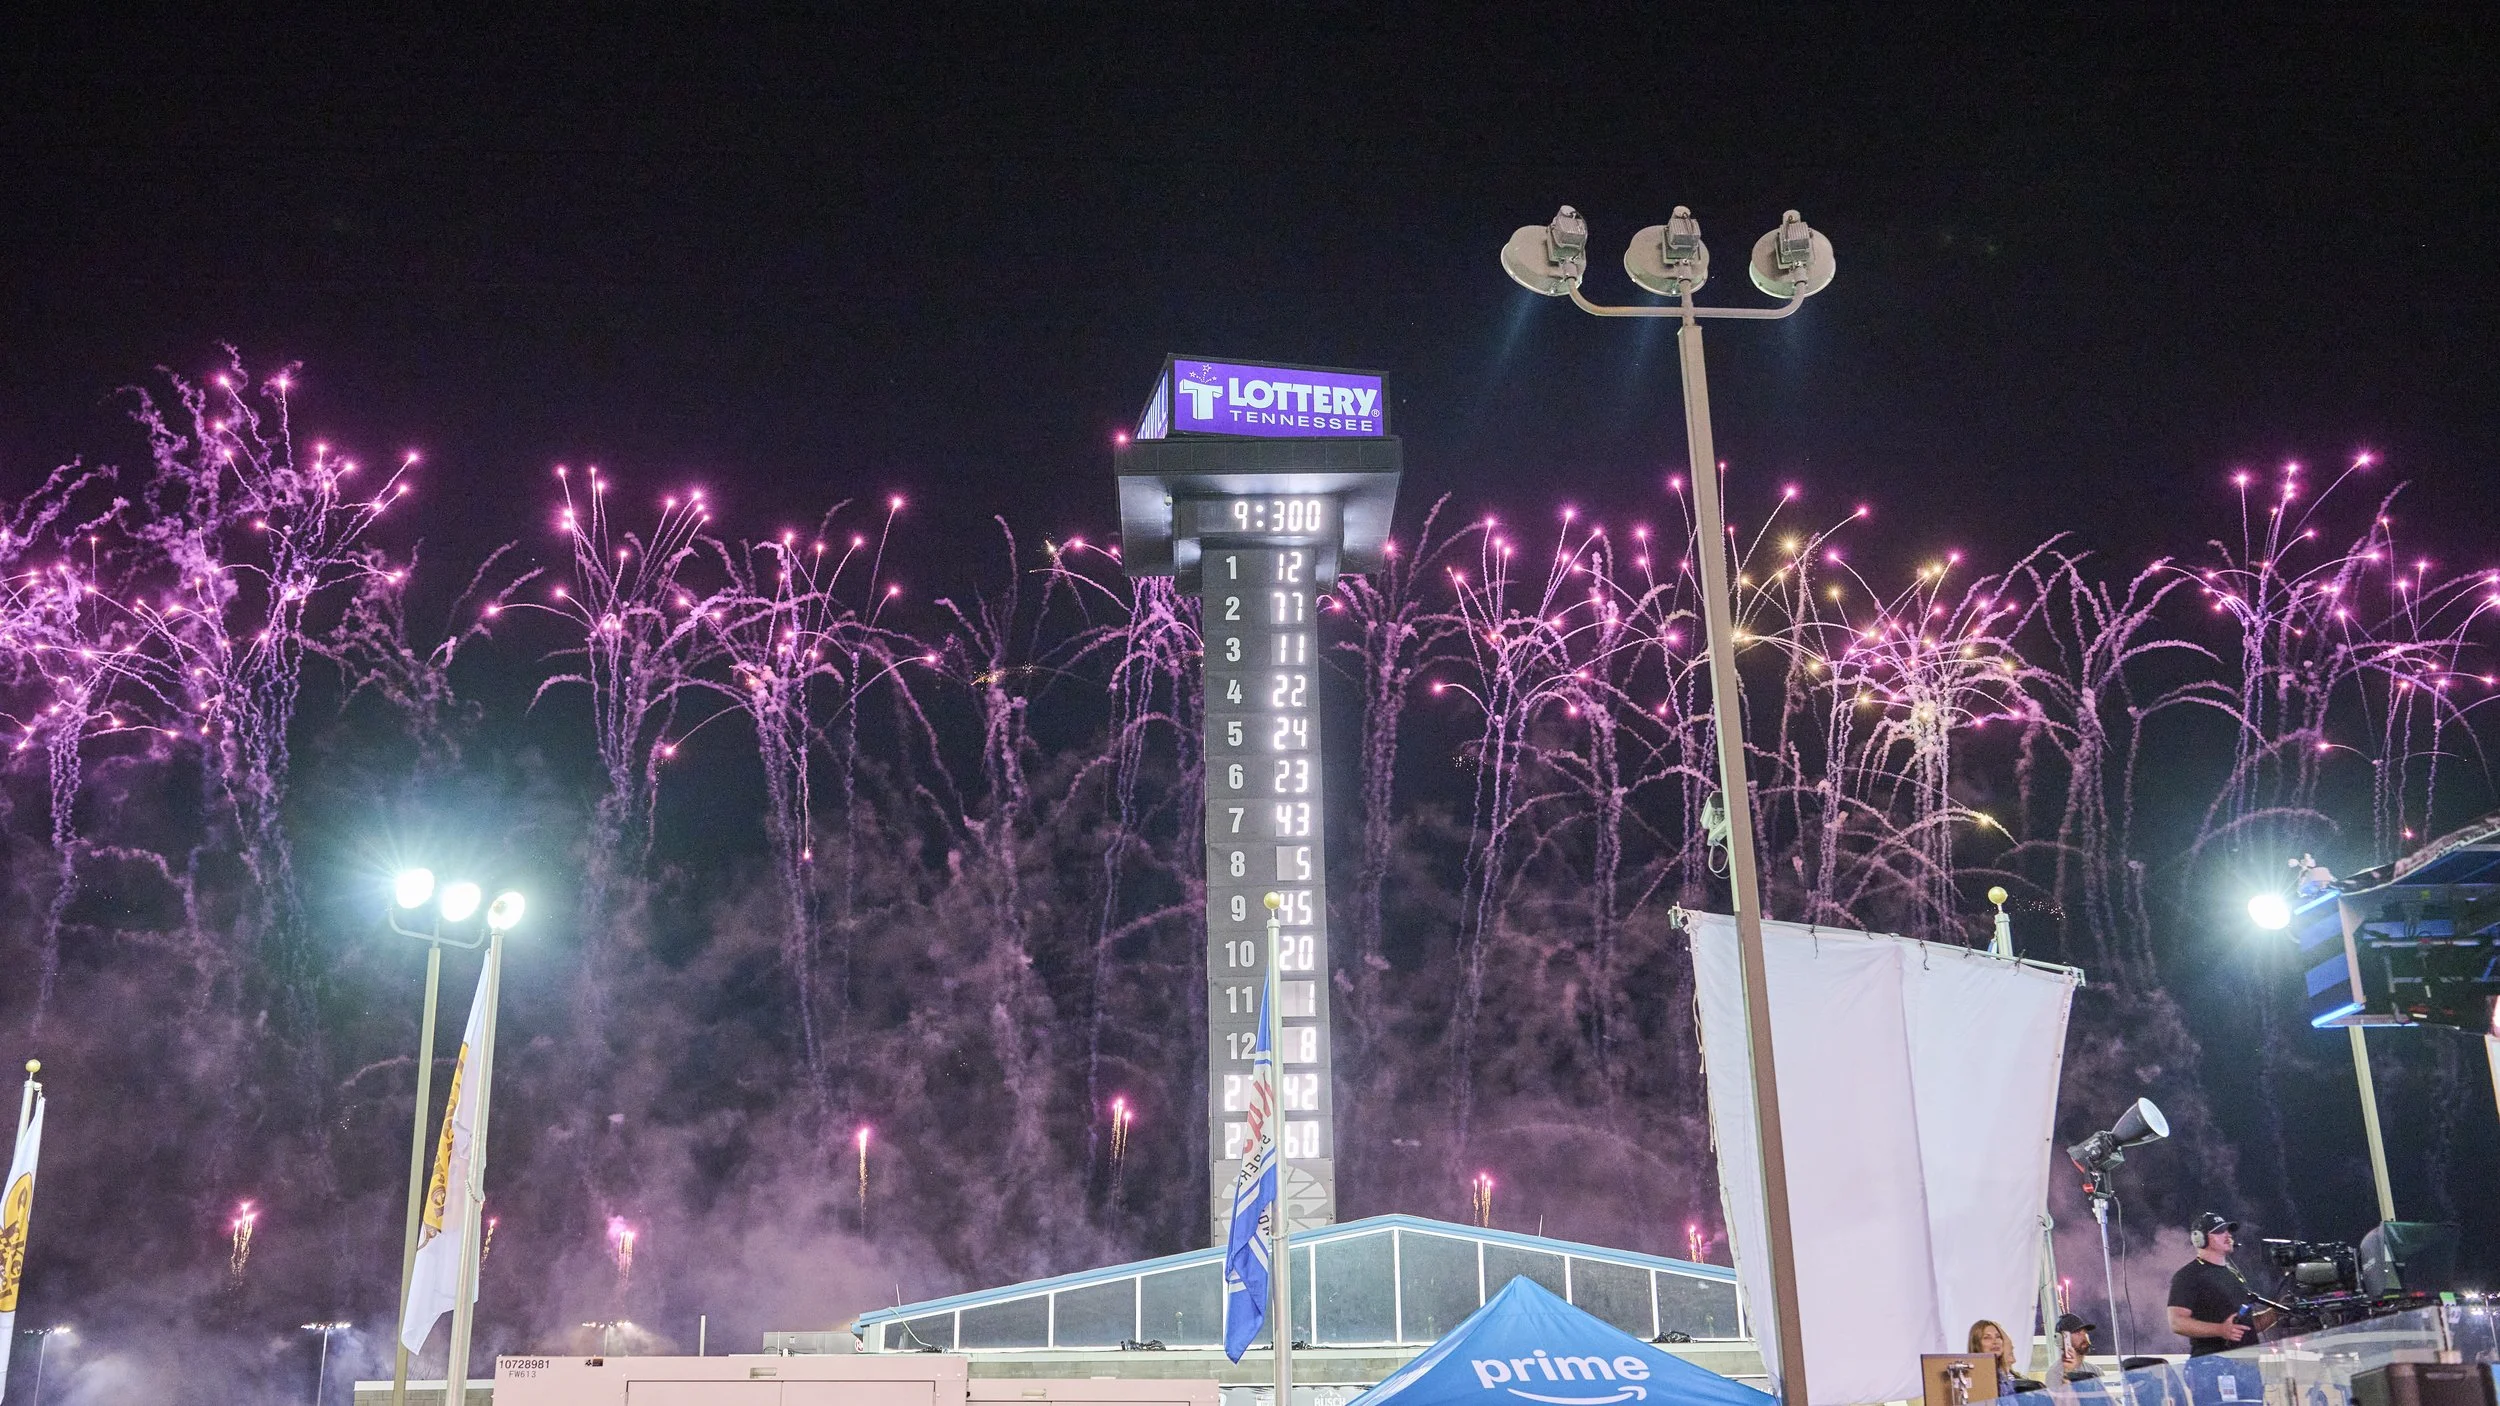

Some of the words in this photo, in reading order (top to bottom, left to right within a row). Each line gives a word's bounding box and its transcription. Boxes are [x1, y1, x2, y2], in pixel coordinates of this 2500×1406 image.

[1229, 377, 1378, 417] LOTTERY
[1229, 410, 1373, 432] TENNESSEE
[1234, 500, 1321, 532] 9:300
[1226, 555, 1237, 580] 1
[1278, 551, 1302, 583] 12
[1225, 596, 1241, 621] 2
[1273, 591, 1303, 622] 77
[1225, 637, 1241, 662] 3
[1280, 635, 1305, 664] 11
[1226, 679, 1242, 704] 4
[1272, 674, 1306, 708] 22
[1227, 721, 1243, 746] 5
[1273, 717, 1307, 750] 24
[1228, 763, 1244, 790] 6
[1275, 759, 1308, 793] 23
[1228, 807, 1244, 833] 7
[1276, 802, 1310, 837] 43
[1230, 850, 1245, 877] 8
[1296, 846, 1310, 880] 5
[1231, 895, 1246, 922] 9
[1279, 891, 1312, 925] 45
[1225, 940, 1255, 968] 10
[1279, 935, 1314, 970] 20
[1226, 986, 1253, 1014] 11
[1308, 983, 1315, 1014] 1
[1226, 1032, 1257, 1060] 12
[1300, 1027, 1317, 1063] 8
[499, 1360, 550, 1369] 10728981
[508, 1370, 537, 1378] FW613
[1471, 1349, 1650, 1388] prime
